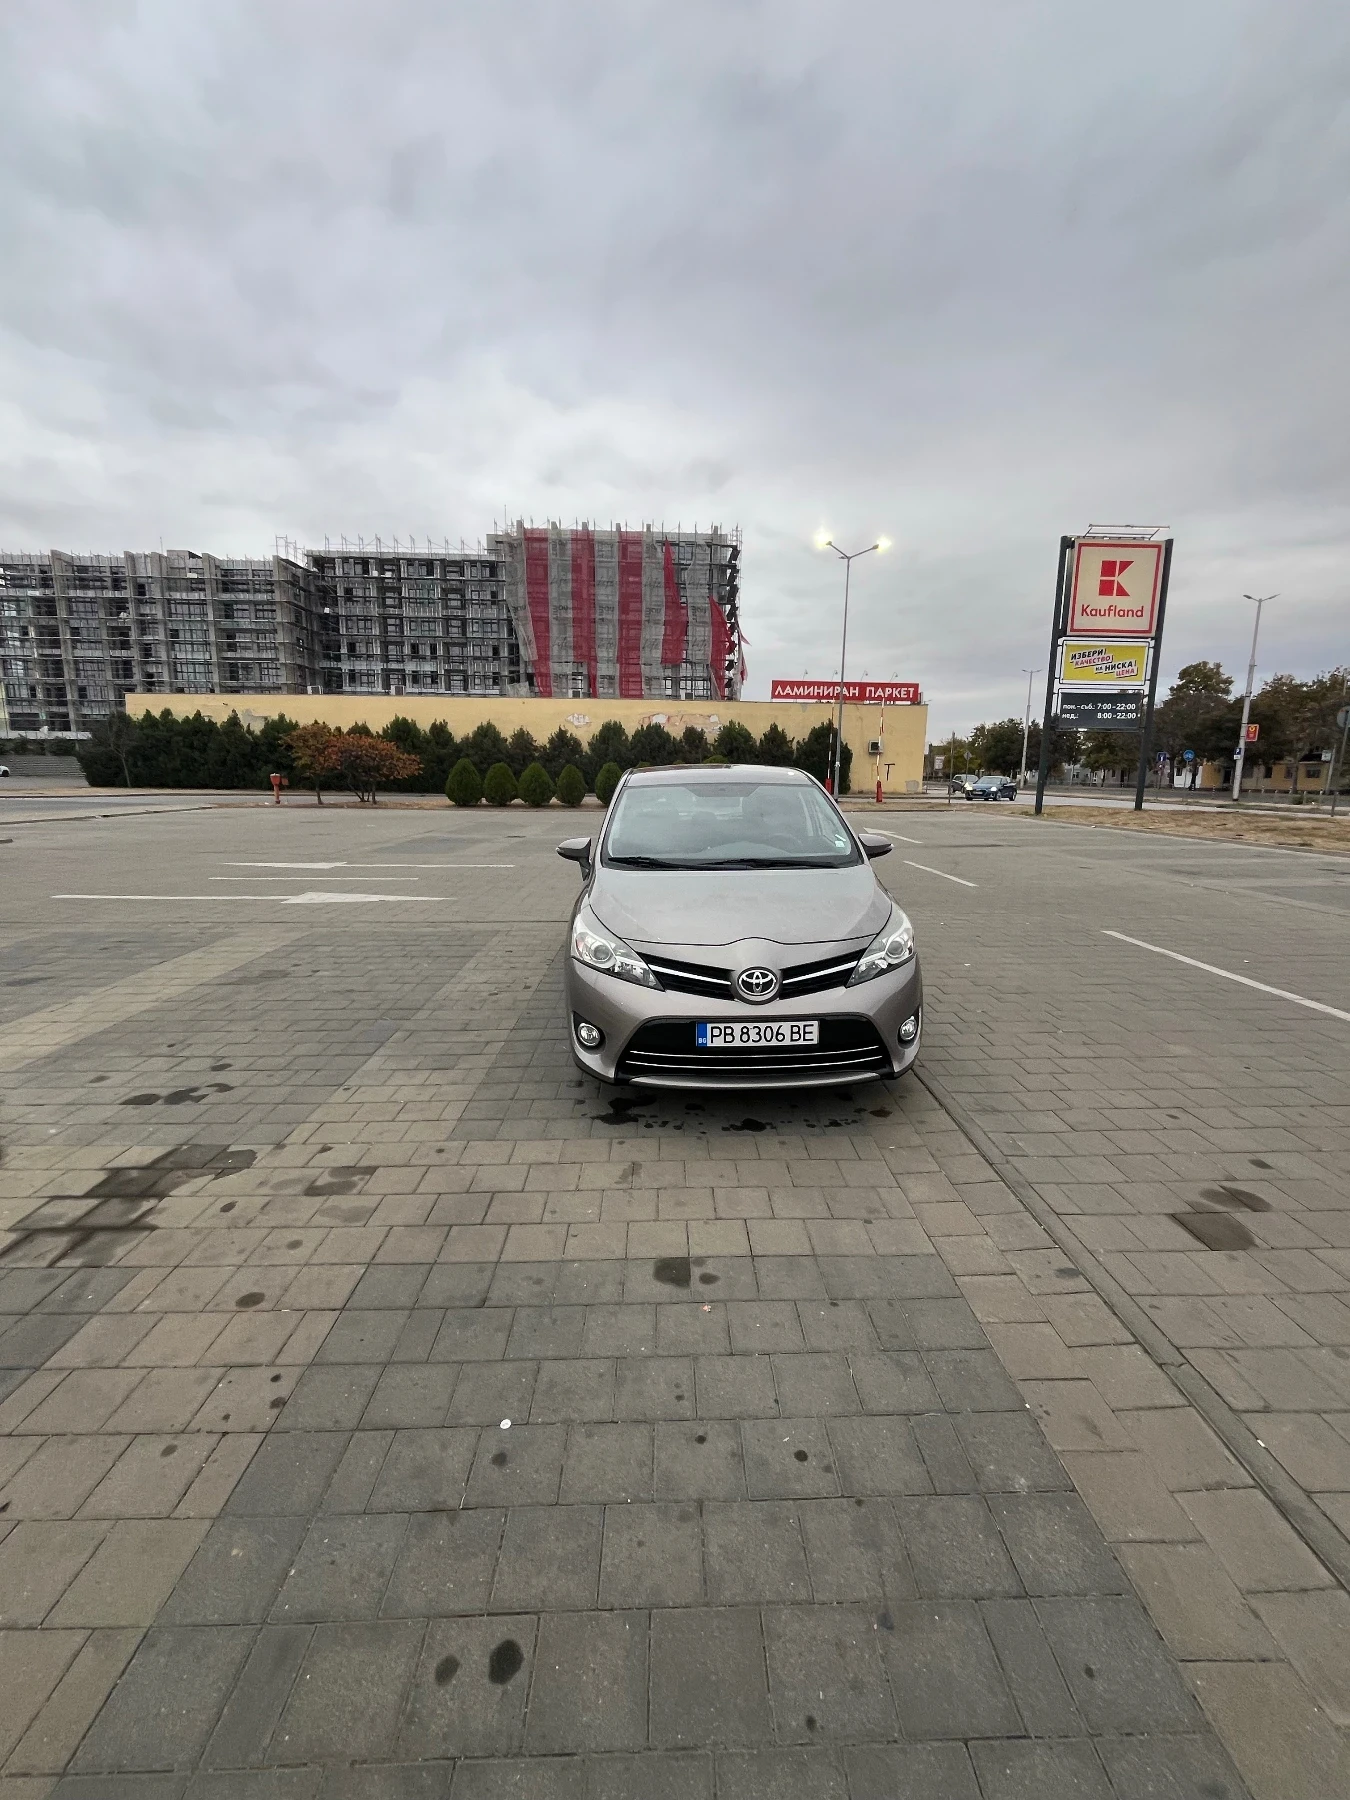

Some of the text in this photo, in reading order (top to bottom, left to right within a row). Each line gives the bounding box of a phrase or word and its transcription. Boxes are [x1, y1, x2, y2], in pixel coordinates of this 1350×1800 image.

[1081, 603, 1144, 618] Kaufland
[1071, 648, 1104, 661] ИЗБЕРИ
[1075, 655, 1111, 667] КАЧЕСТВО
[1105, 661, 1133, 671] НИСКА
[775, 684, 915, 698] ЛАМИНИРАН ПАРКЕТ
[710, 1024, 814, 1044] PB 8306 BE
